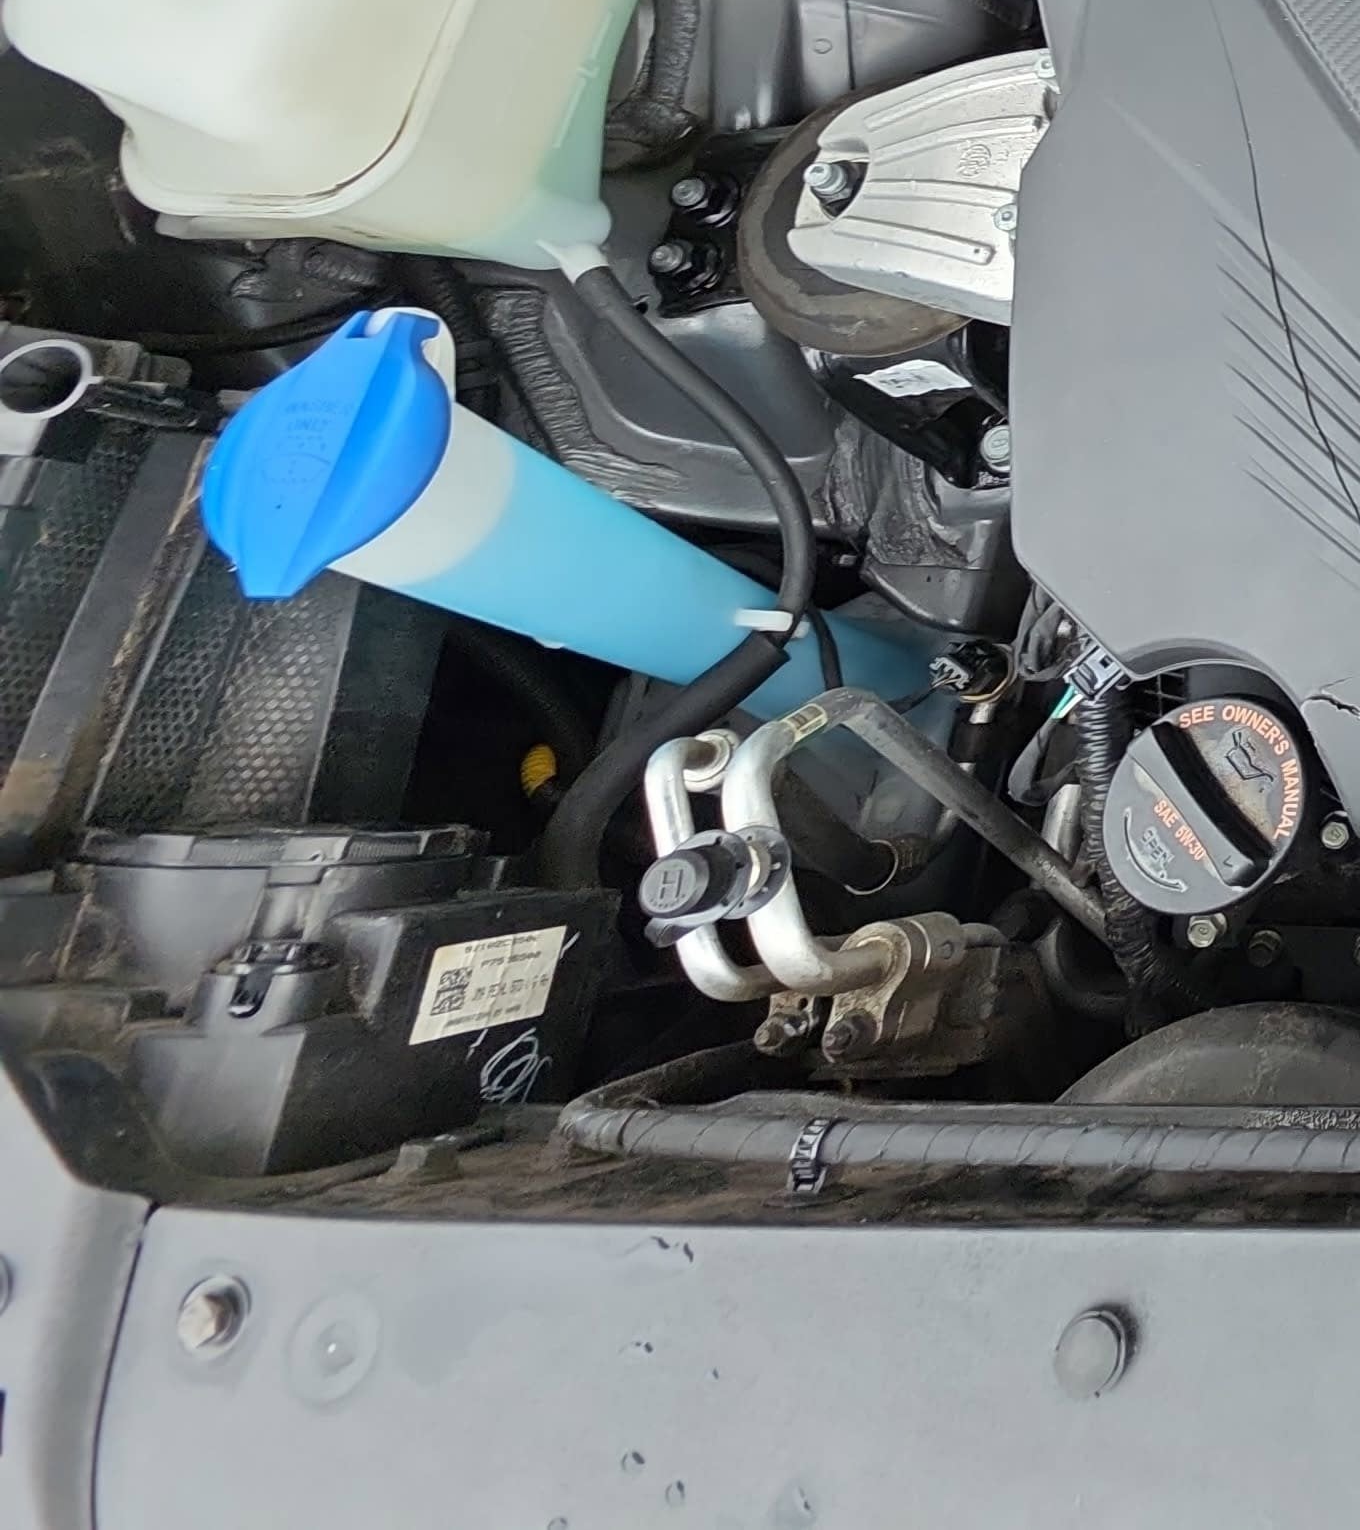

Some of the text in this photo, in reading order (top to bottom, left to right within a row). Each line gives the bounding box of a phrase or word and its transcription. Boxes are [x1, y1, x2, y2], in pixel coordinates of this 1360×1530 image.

[1178, 704, 1300, 841] SEE OWNER'S MANUAL
[1153, 799, 1207, 862] SAE 5W-30
